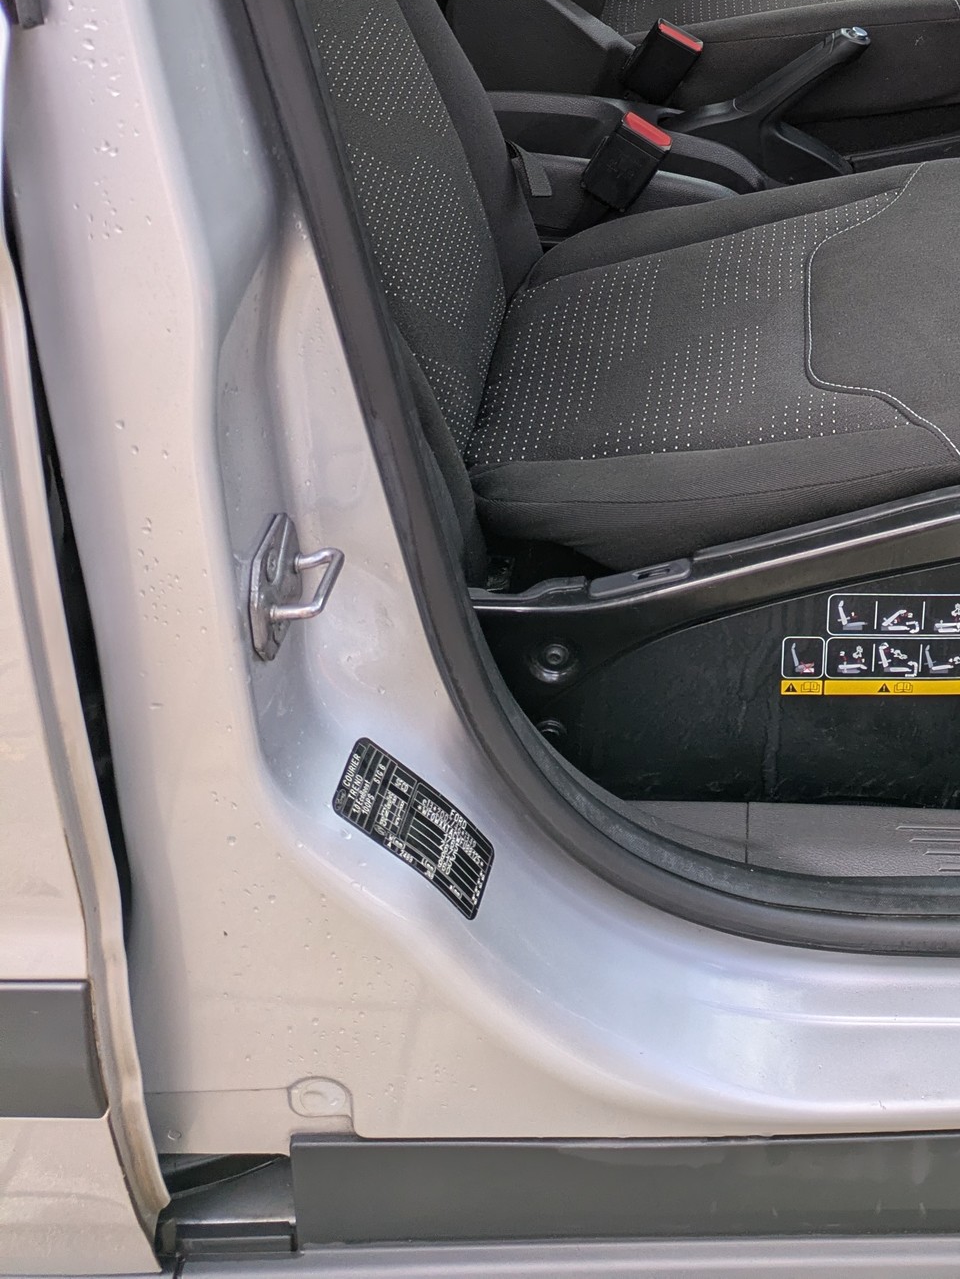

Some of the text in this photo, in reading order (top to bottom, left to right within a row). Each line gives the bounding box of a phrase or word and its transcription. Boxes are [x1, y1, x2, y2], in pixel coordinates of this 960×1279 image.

[343, 754, 361, 787] COURIER
[348, 775, 363, 800] TREND
[449, 808, 467, 830] FORD
